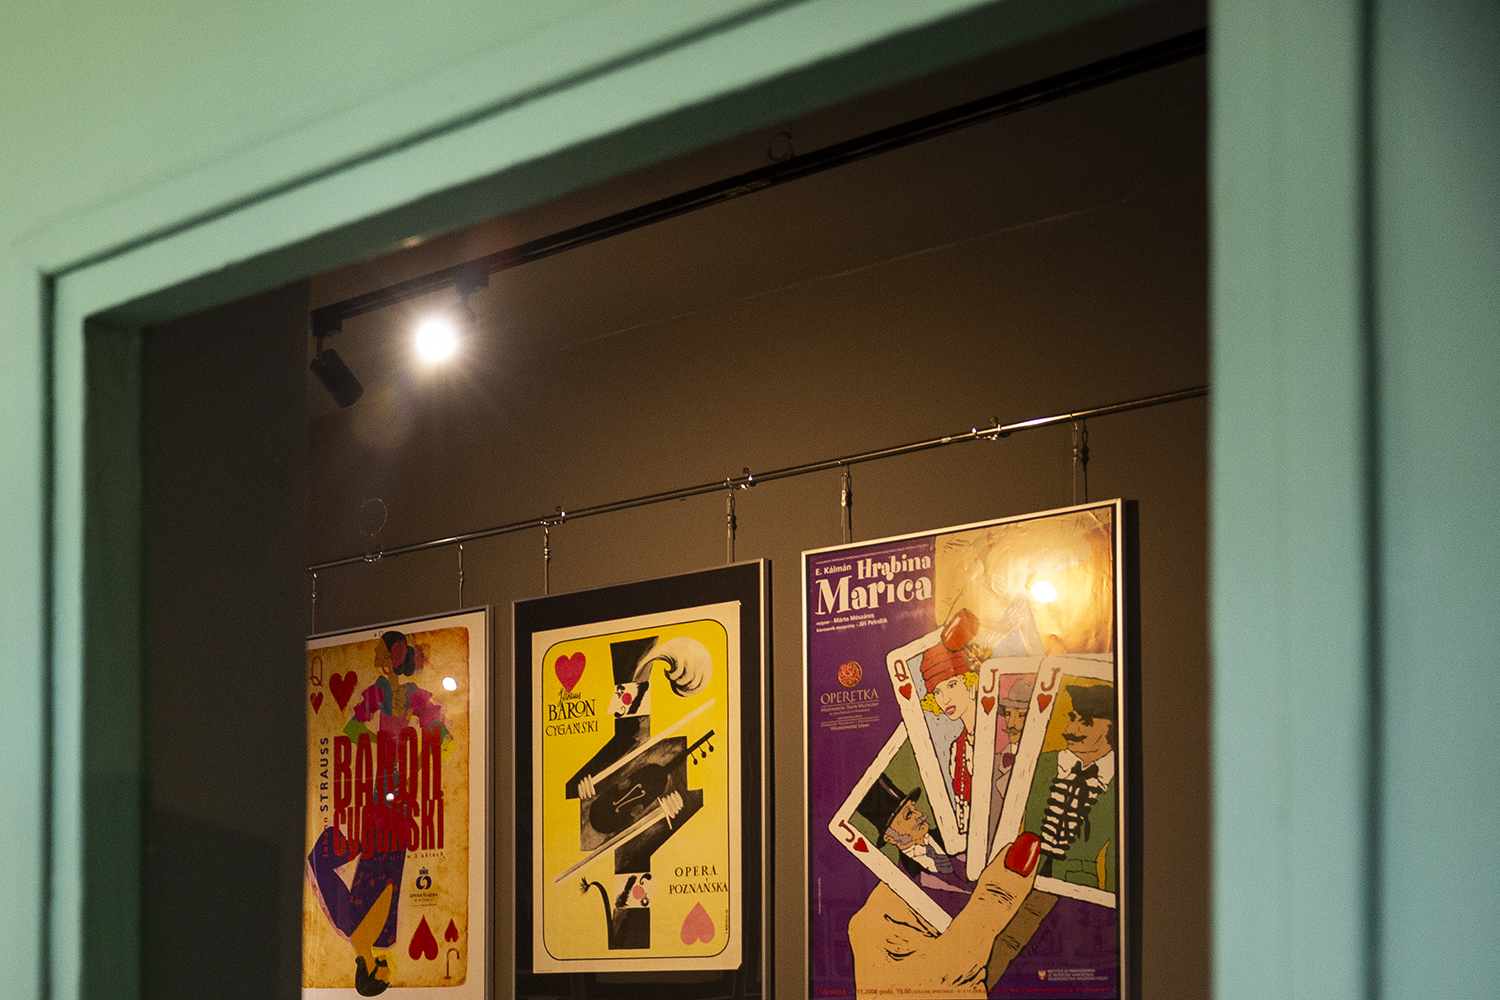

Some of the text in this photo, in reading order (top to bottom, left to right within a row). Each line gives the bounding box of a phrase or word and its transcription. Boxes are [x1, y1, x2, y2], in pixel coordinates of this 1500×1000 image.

[815, 568, 822, 576] E.
[824, 564, 852, 575] Kálmán
[857, 554, 932, 580] Hrabina
[815, 572, 932, 616] Marica
[310, 656, 324, 686] Q
[894, 659, 908, 682] Q
[982, 668, 998, 694] J
[1040, 668, 1060, 692] J
[820, 688, 878, 704] OPERETKA
[548, 698, 596, 721] BARON
[320, 737, 329, 812] STRAUSS
[334, 724, 442, 809] BARON
[838, 820, 855, 842] J
[674, 865, 718, 877] OPERA
[669, 878, 728, 894] POZNAŃSKA
